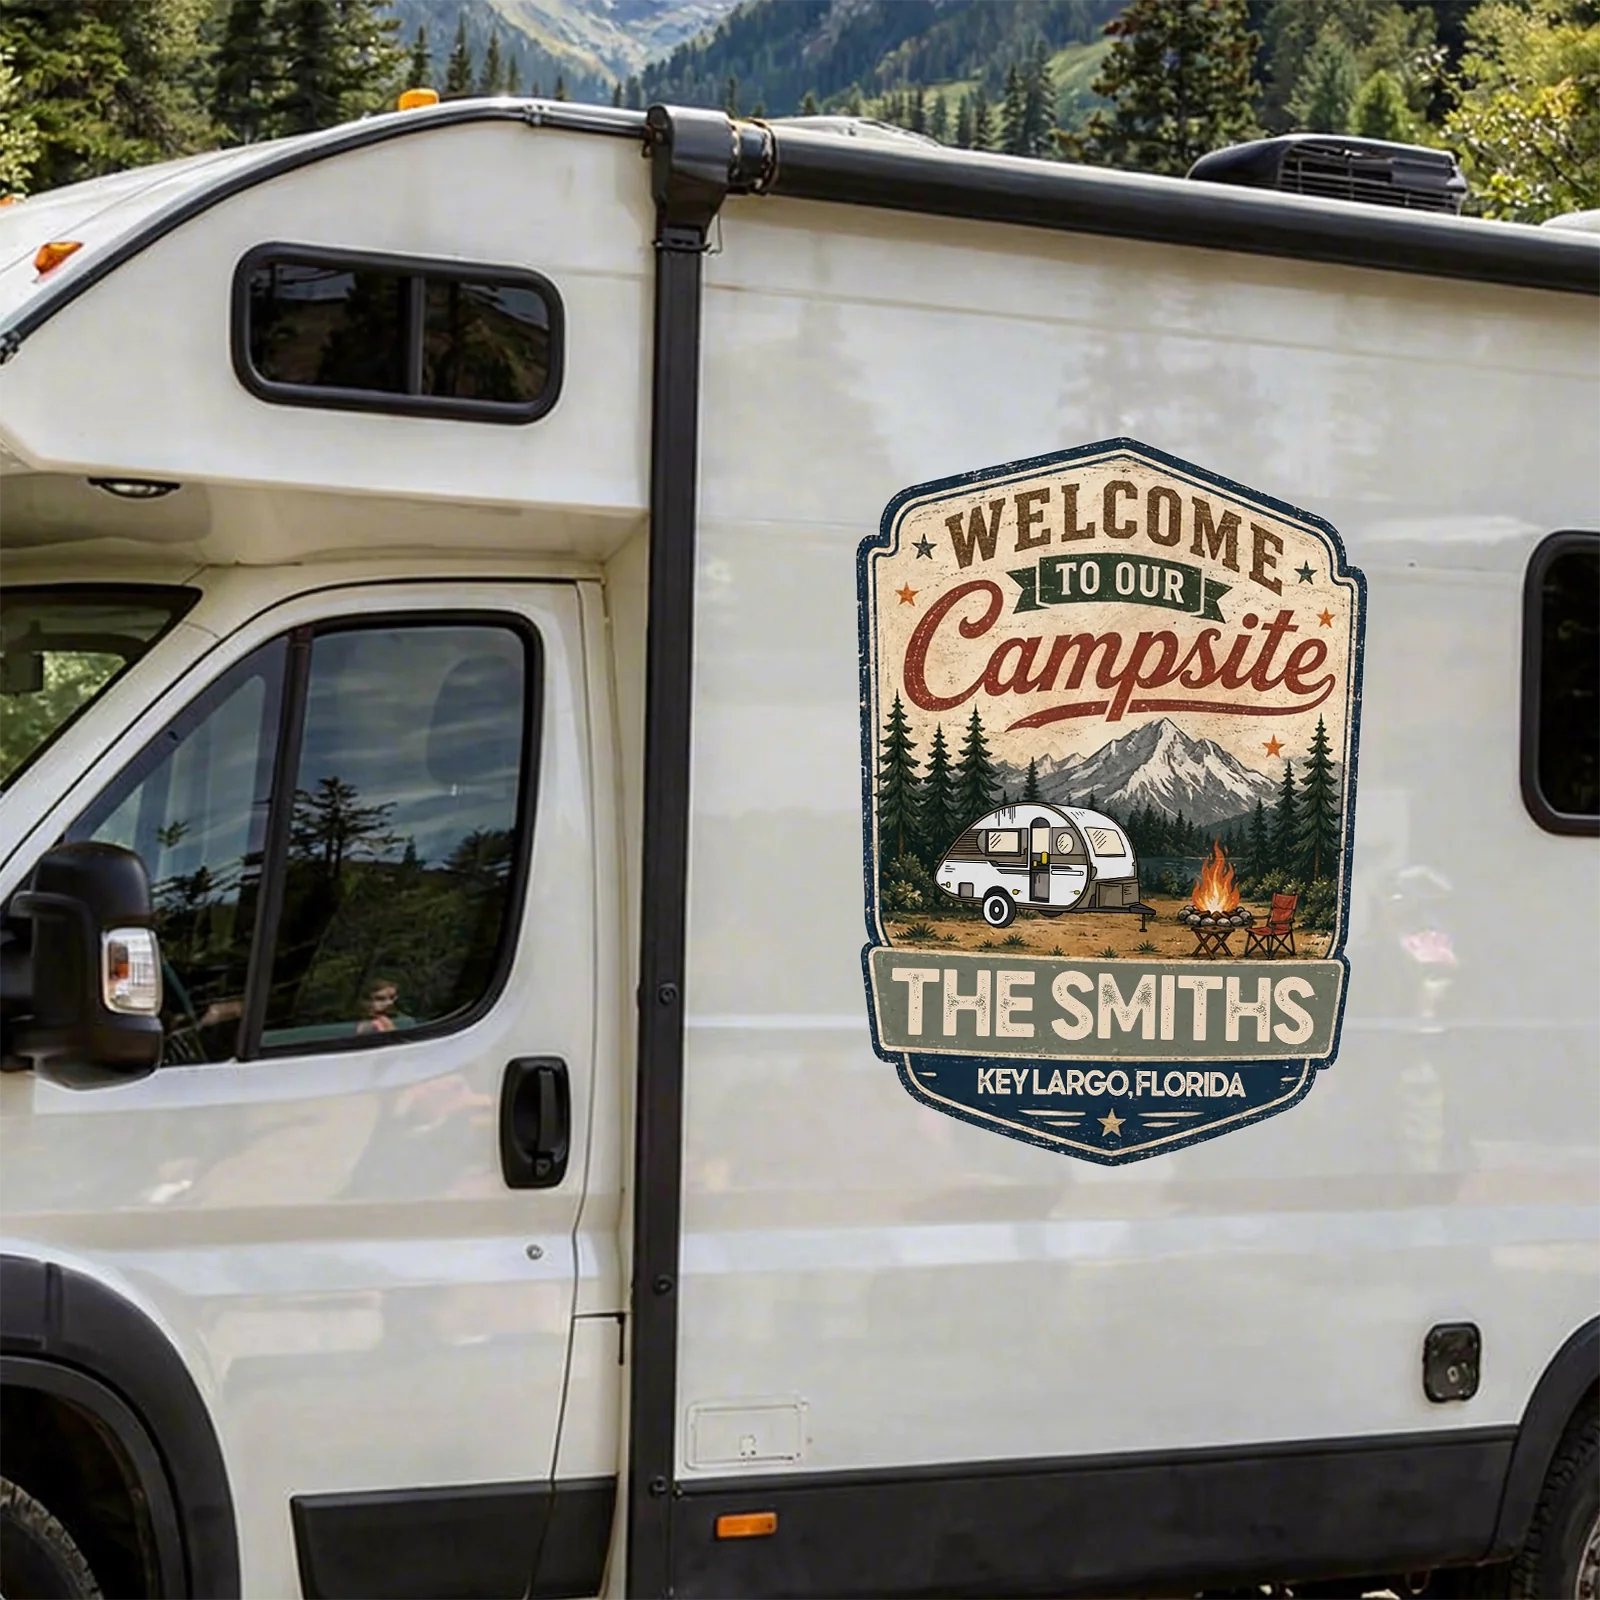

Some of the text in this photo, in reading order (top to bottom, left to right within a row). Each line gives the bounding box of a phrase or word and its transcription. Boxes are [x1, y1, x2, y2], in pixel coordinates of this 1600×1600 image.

[944, 479, 1284, 596] WELCOME
[1055, 561, 1186, 603] TO OUR
[903, 579, 1335, 731] Campsite
[891, 967, 1315, 1044] THE SMITHS
[977, 1068, 1028, 1095] KEY
[1136, 1070, 1246, 1098] FLORIDA
